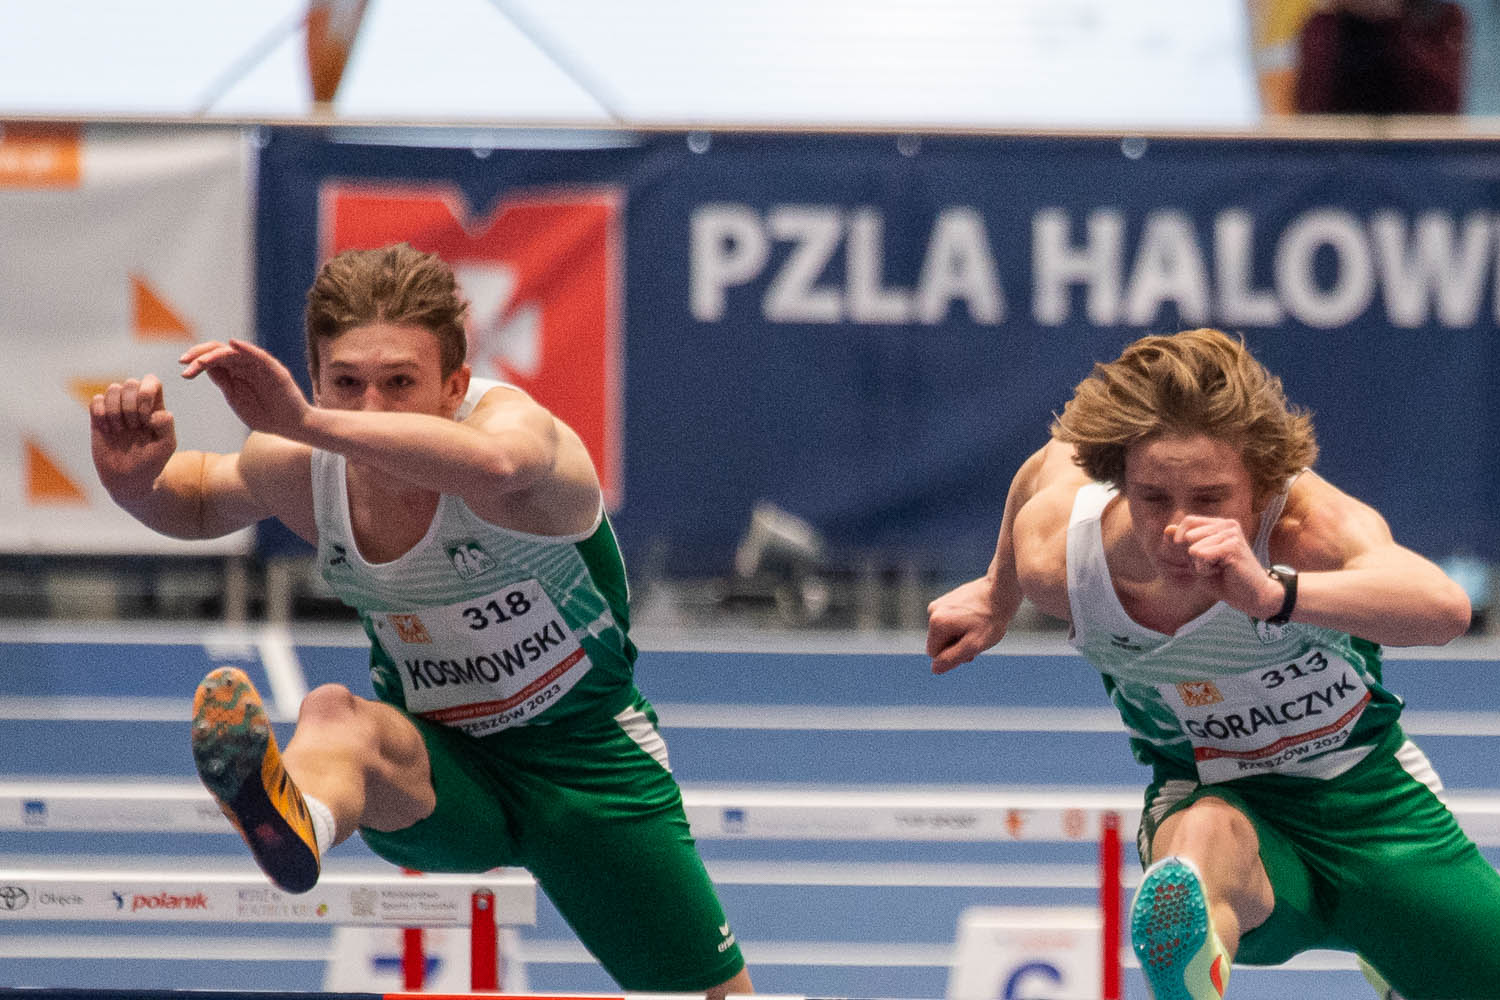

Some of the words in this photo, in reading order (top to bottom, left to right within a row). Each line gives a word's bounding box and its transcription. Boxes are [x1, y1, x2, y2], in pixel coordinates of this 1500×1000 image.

[689, 203, 1004, 327] PZLA
[462, 590, 532, 631] 318
[405, 619, 567, 691] KOSMOWSKI
[1260, 651, 1329, 689] 313
[463, 708, 526, 732] ZESZÓW
[526, 684, 562, 711] 2023
[1184, 672, 1357, 740] GÓRALCZYK
[132, 891, 208, 912] polanik
